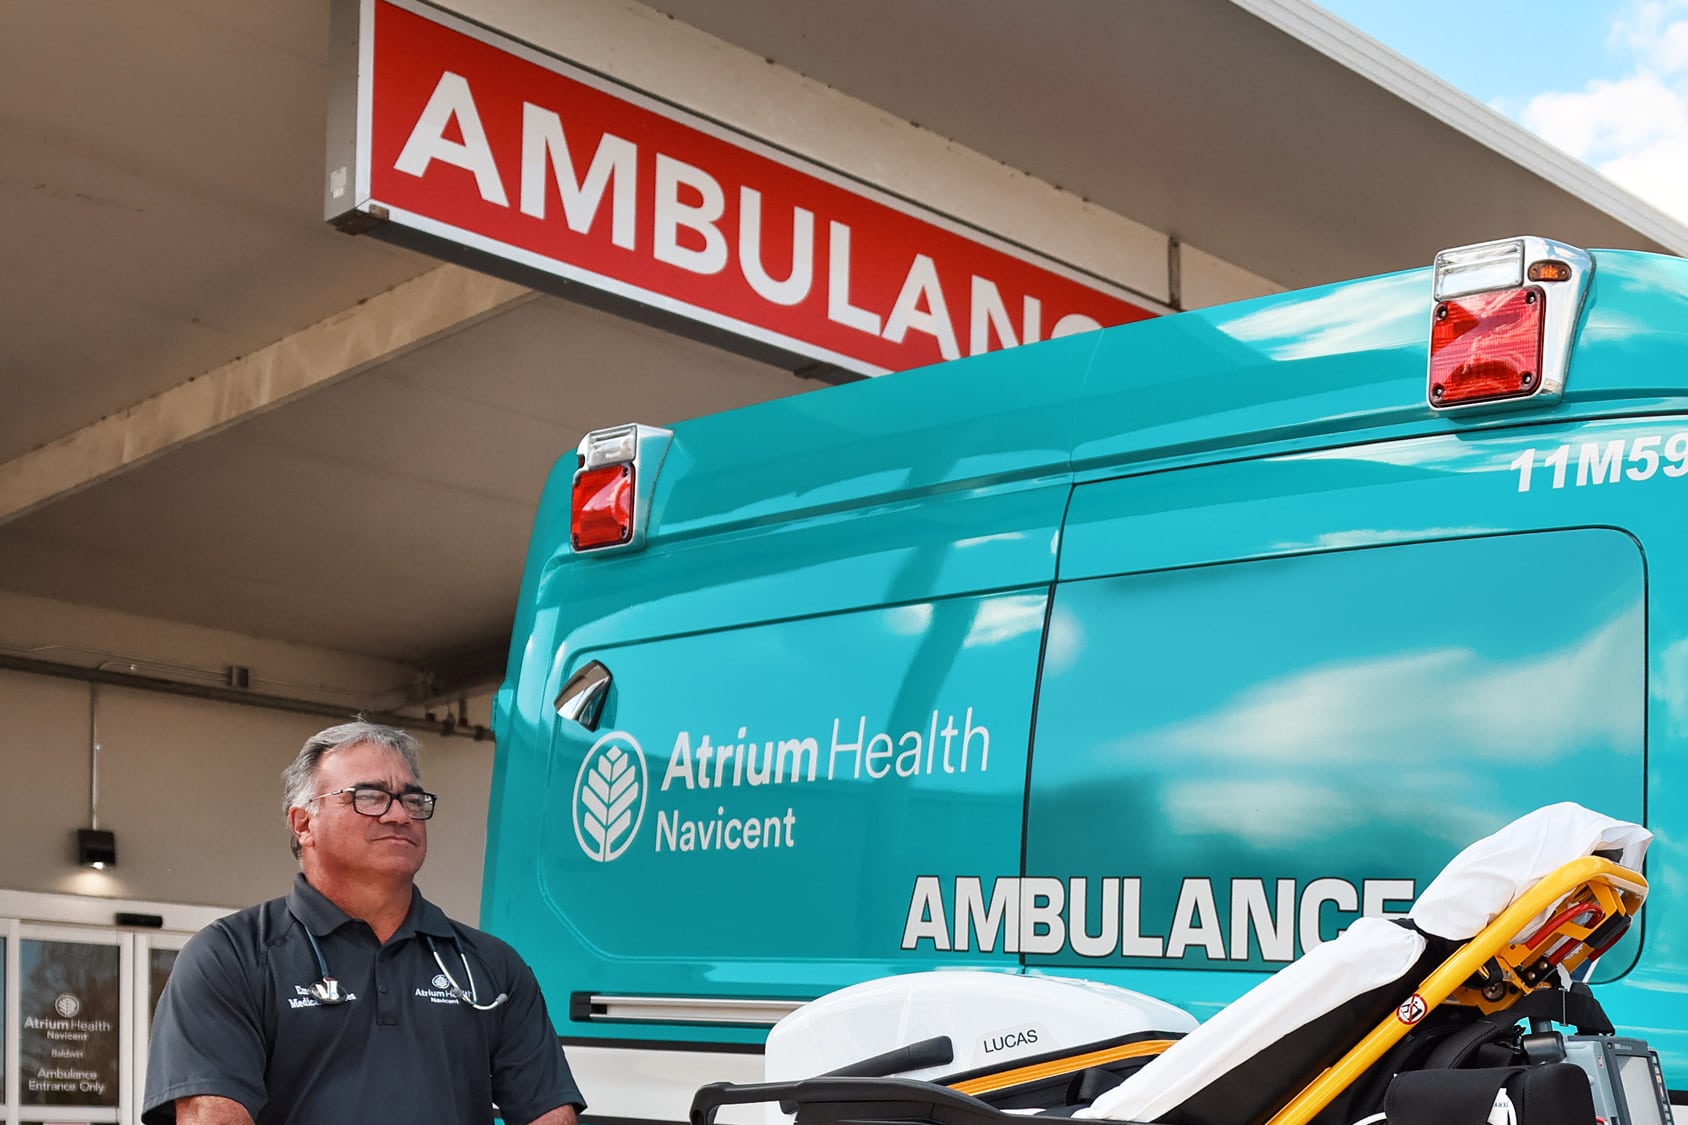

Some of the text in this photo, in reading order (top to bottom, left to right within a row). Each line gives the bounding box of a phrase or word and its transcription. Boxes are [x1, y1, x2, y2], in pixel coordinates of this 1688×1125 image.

[394, 70, 1104, 361] AMBULAN
[660, 706, 990, 791] Atrium Health
[655, 806, 797, 852] Navicent
[415, 988, 445, 998] Atrium
[24, 1015, 111, 1033] Atrium Health
[46, 1030, 88, 1041] Navicent
[983, 1029, 1039, 1053] LUCAS
[37, 1067, 98, 1080] Ambulance
[28, 1080, 105, 1095] Entrance Only
